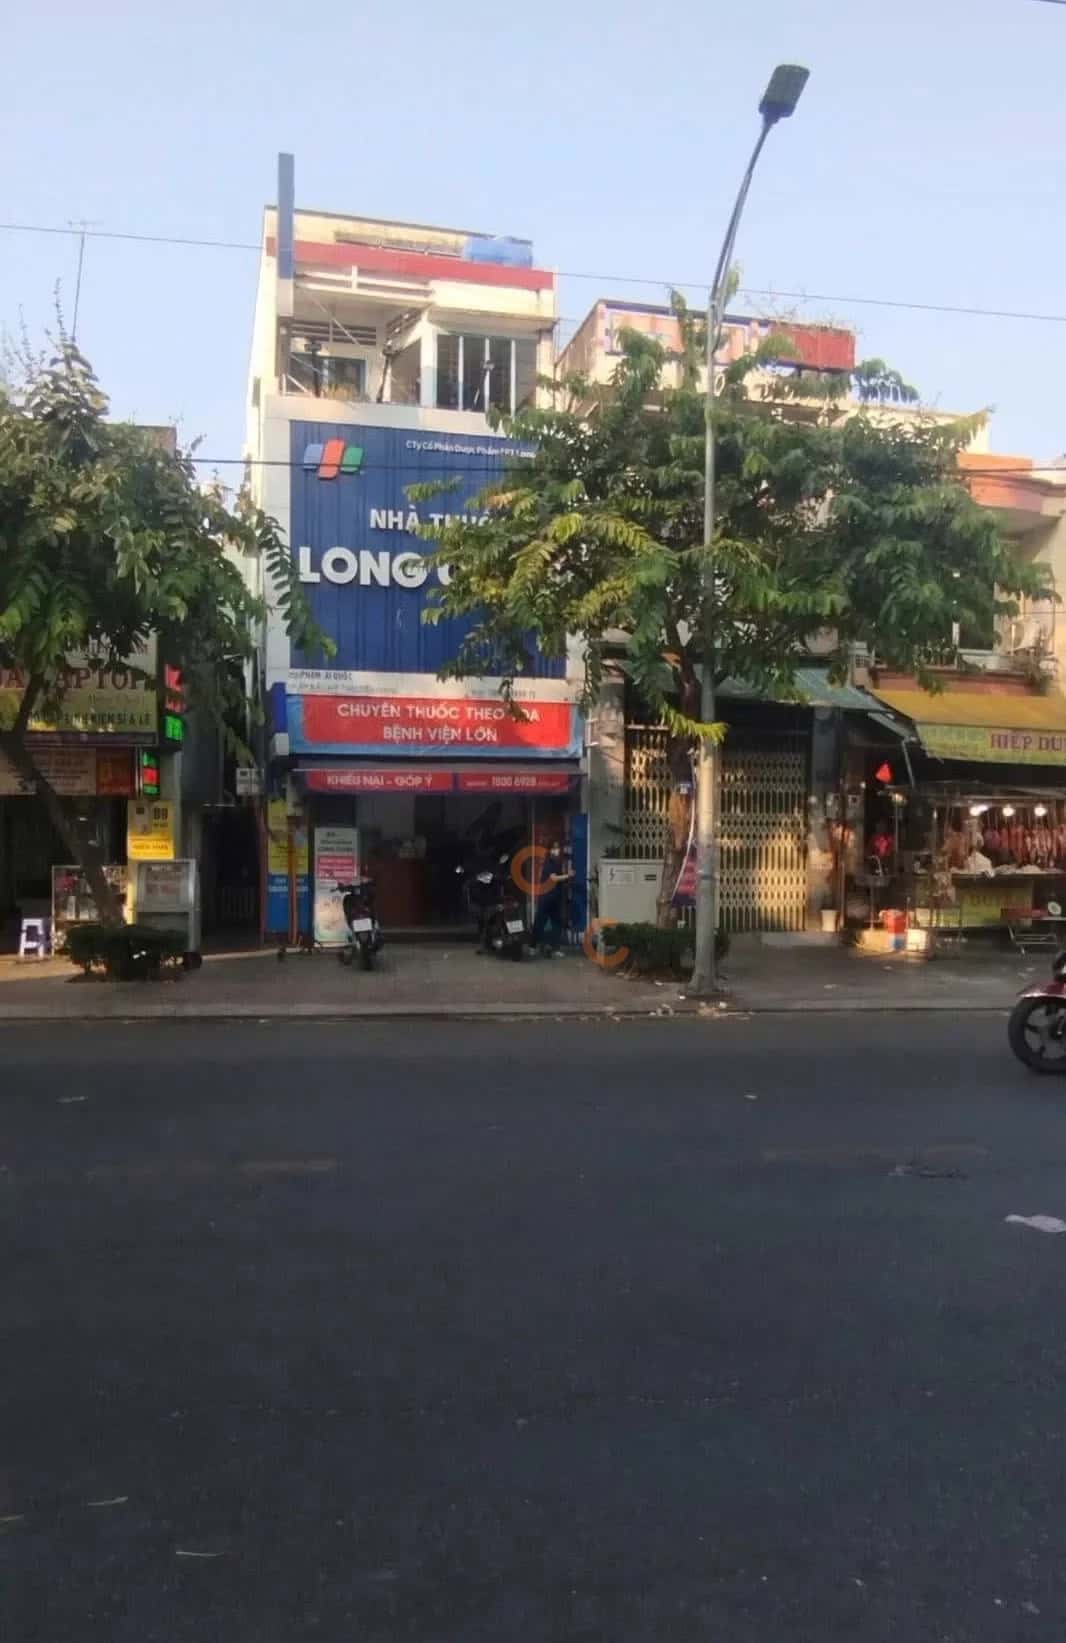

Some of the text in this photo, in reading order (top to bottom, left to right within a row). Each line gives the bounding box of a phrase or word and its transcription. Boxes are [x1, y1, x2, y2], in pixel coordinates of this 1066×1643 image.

[369, 504, 419, 531] NHÀ
[299, 546, 428, 588] LONG
[337, 702, 400, 718] CHUYÊN
[405, 703, 459, 720] THUỐC
[466, 707, 505, 721] THEO
[383, 724, 423, 744] BỆNH
[428, 725, 461, 744] VIỆN
